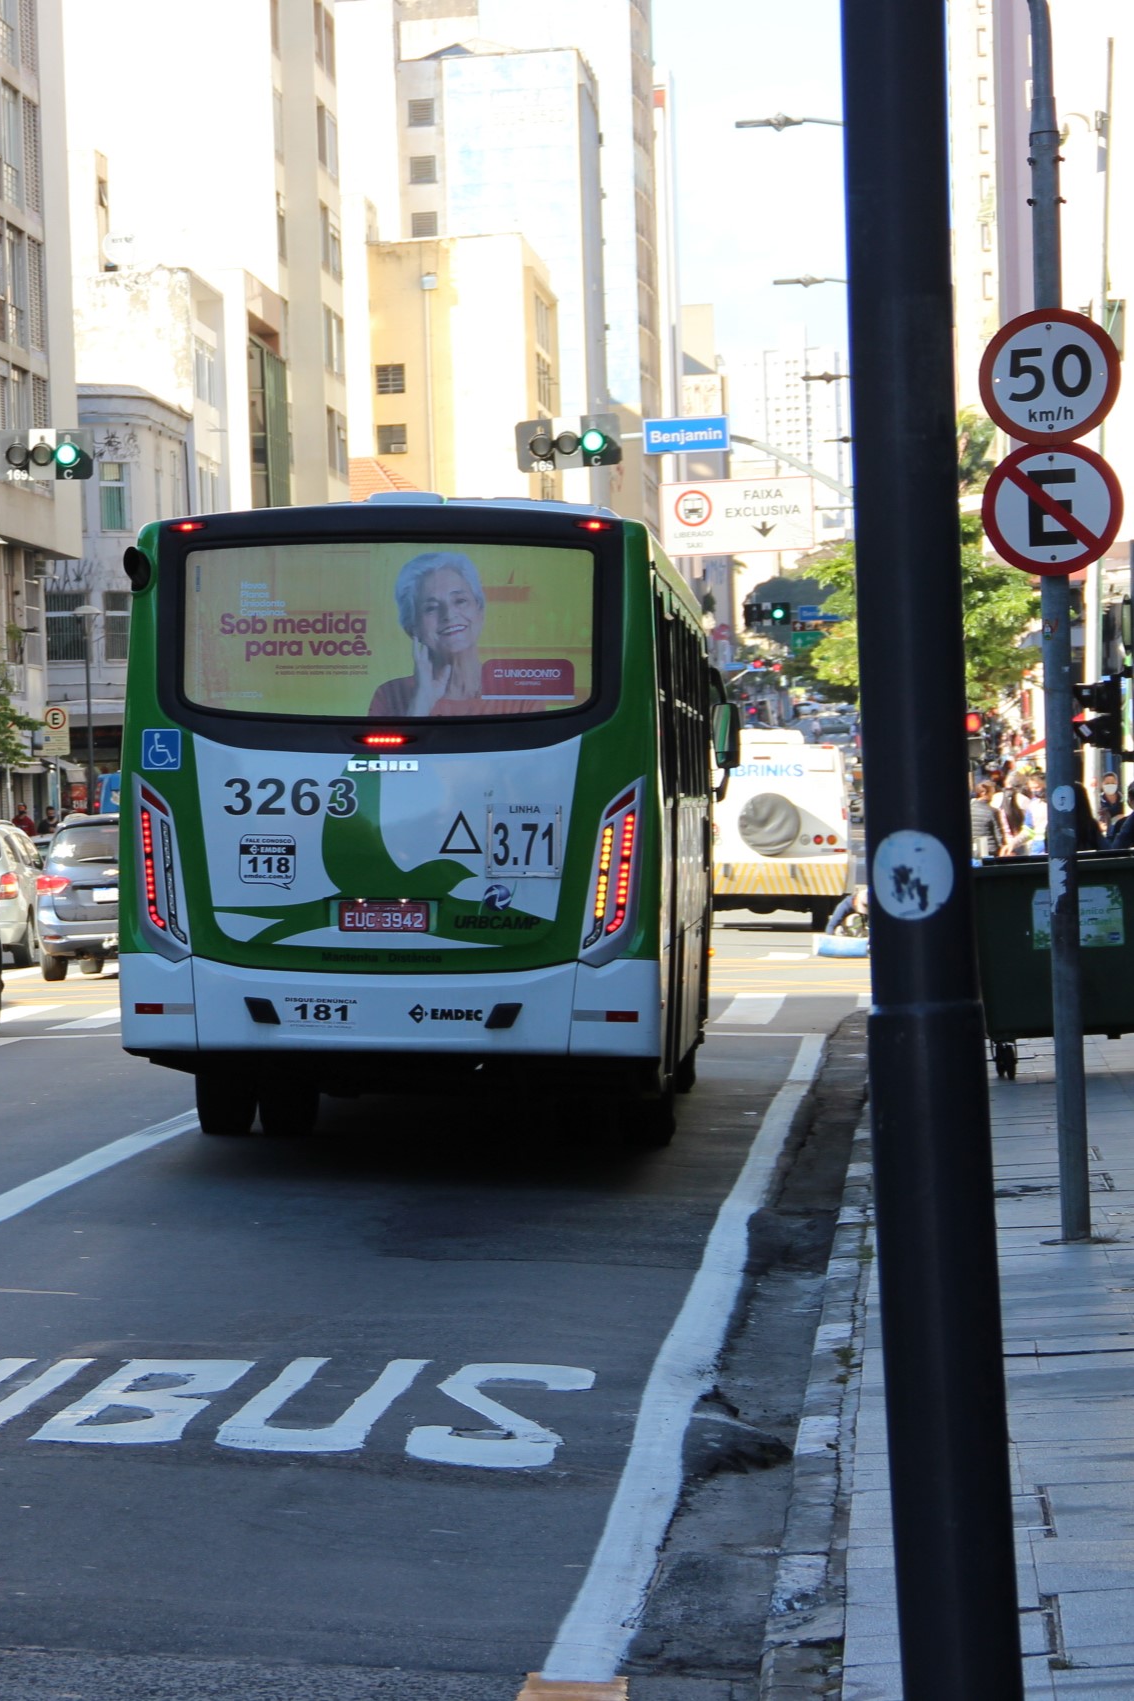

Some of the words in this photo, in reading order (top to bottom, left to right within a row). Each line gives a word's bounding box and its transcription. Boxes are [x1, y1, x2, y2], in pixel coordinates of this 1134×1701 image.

[1009, 344, 1092, 402] 50
[1028, 406, 1074, 422] km/h
[650, 428, 723, 445] Benjamin
[744, 489, 783, 500] FAIXA
[725, 505, 801, 518] EXCLUSIVA
[674, 530, 714, 539] LIBERADO
[220, 612, 267, 635] Sob
[273, 612, 367, 634] medida
[245, 640, 303, 662] para
[308, 634, 372, 656] você.
[504, 669, 561, 678] UNIODONTO
[52, 713, 59, 725] E
[348, 760, 419, 772] CAIO
[223, 777, 357, 817] 3263
[509, 805, 541, 814] LINHA
[493, 822, 554, 867] 3.71
[248, 857, 290, 874] 118
[454, 915, 541, 929] URBCAMP
[322, 952, 379, 963] Mantenha
[388, 952, 443, 963] Distância
[294, 1003, 348, 1021] 181
[431, 1009, 483, 1021] EMDEC
